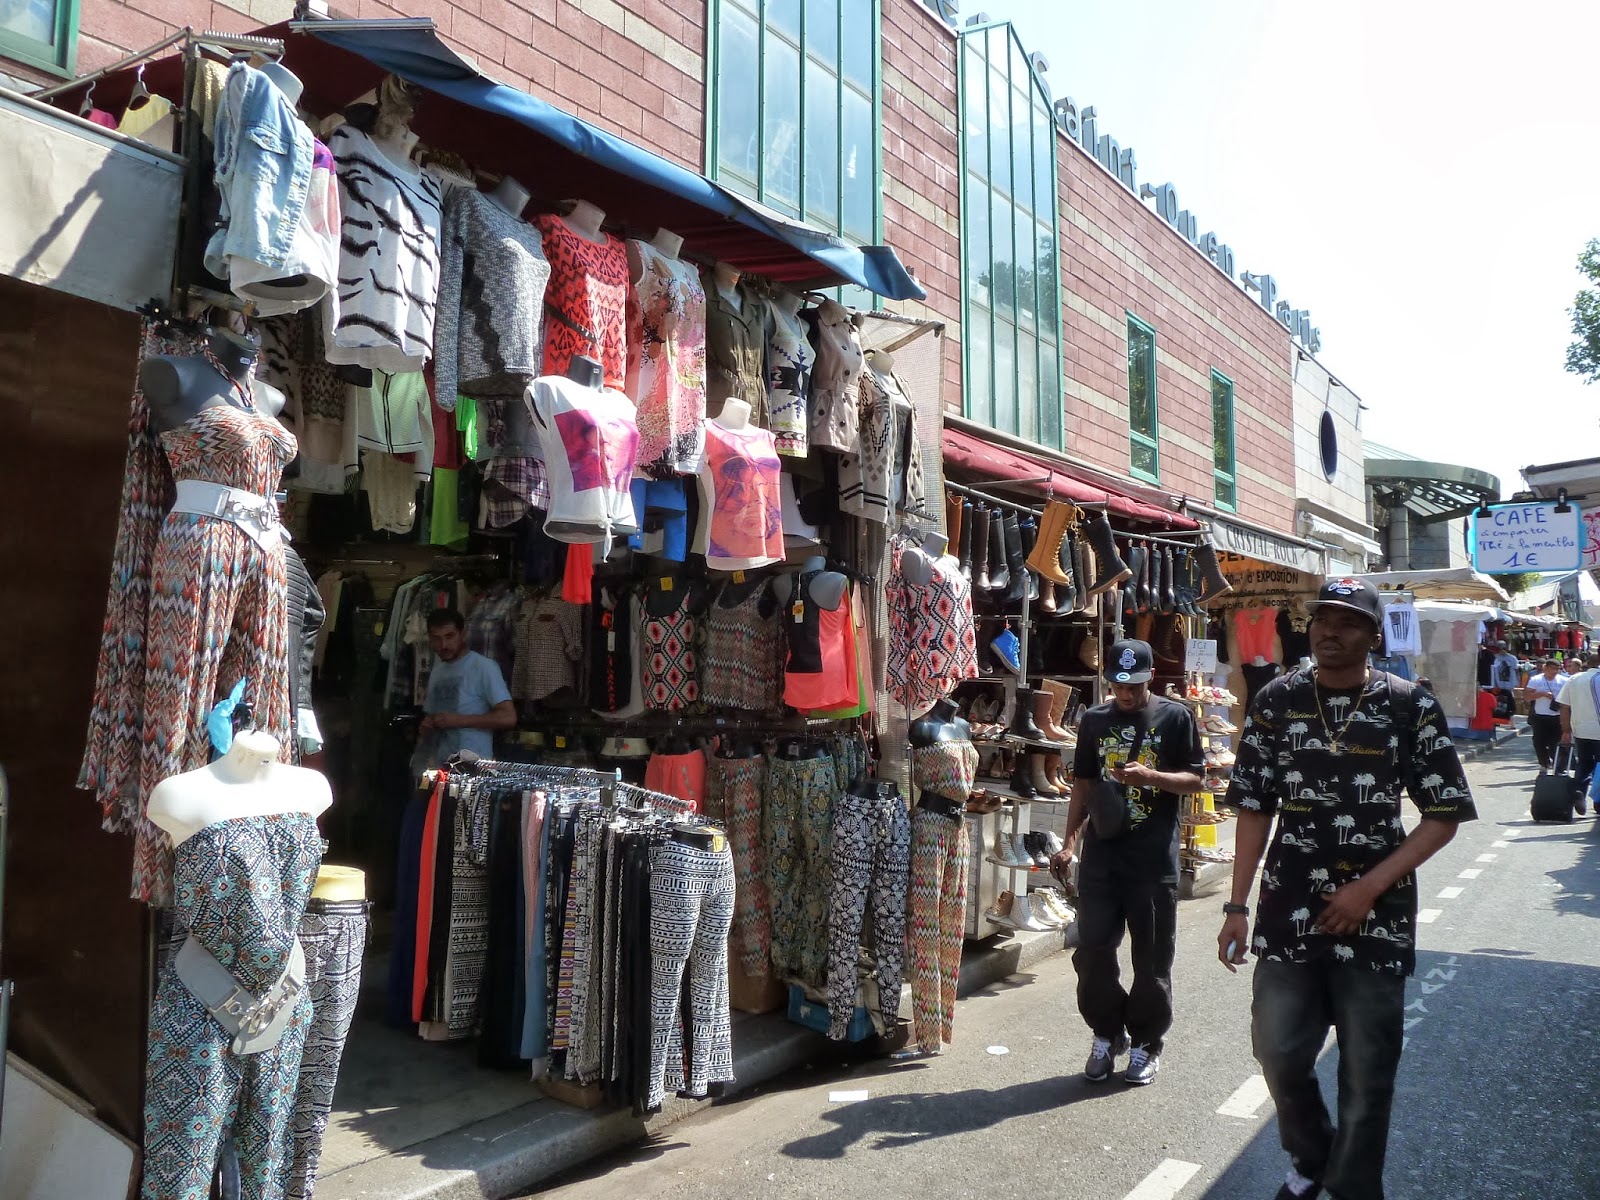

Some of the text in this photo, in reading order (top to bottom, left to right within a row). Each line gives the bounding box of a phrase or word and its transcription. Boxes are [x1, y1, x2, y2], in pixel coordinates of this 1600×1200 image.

[1494, 507, 1548, 527] CAFE
[1226, 524, 1299, 565] CRYSTAL ROCK
[1402, 955, 1462, 1051] AYANT
